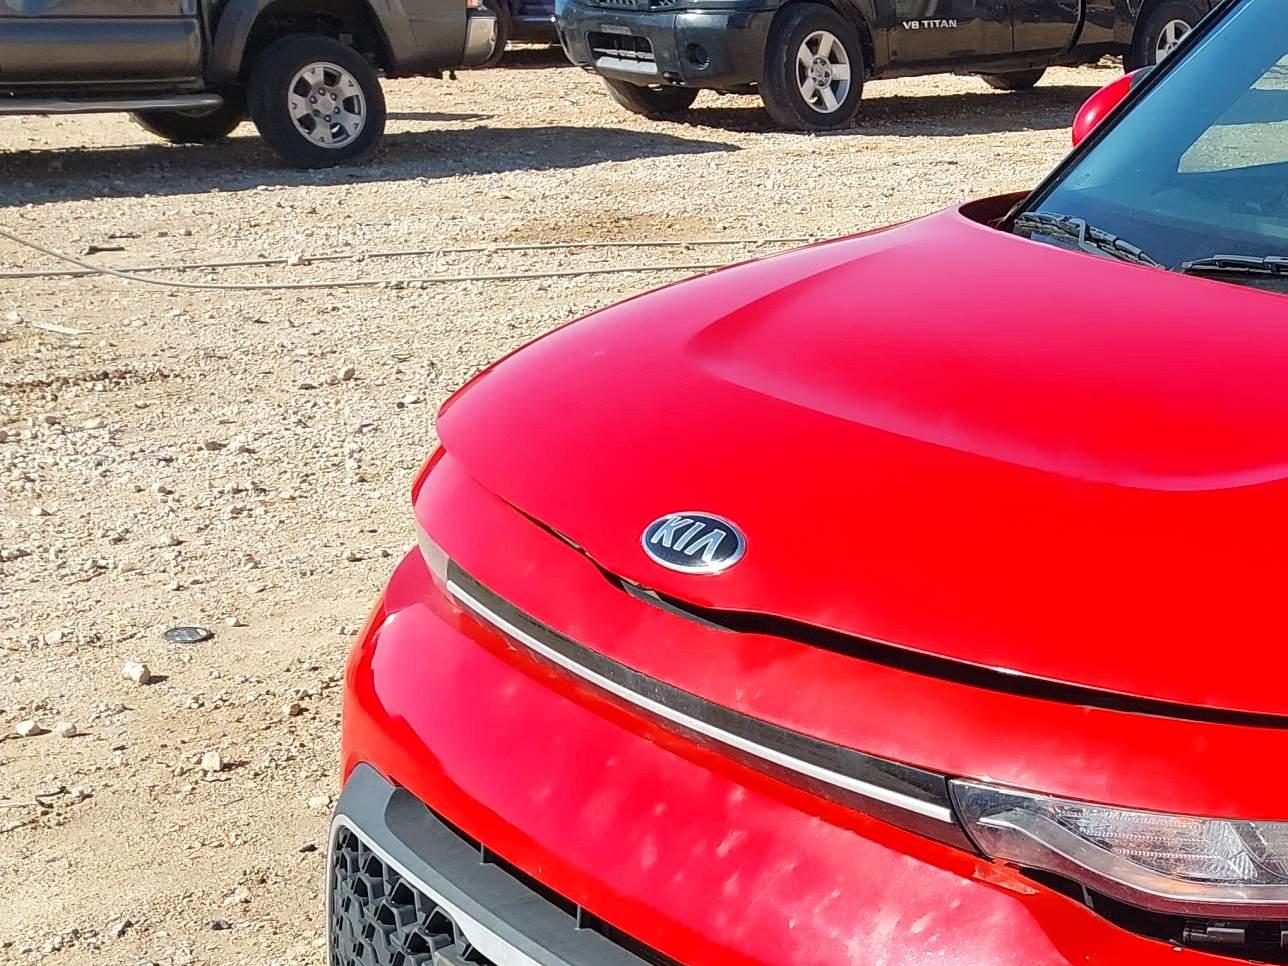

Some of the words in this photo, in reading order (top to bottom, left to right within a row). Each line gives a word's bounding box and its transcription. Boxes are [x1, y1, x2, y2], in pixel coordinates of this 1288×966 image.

[902, 20, 919, 30] V8
[921, 19, 957, 29] TITAN
[650, 516, 726, 561] KIA
